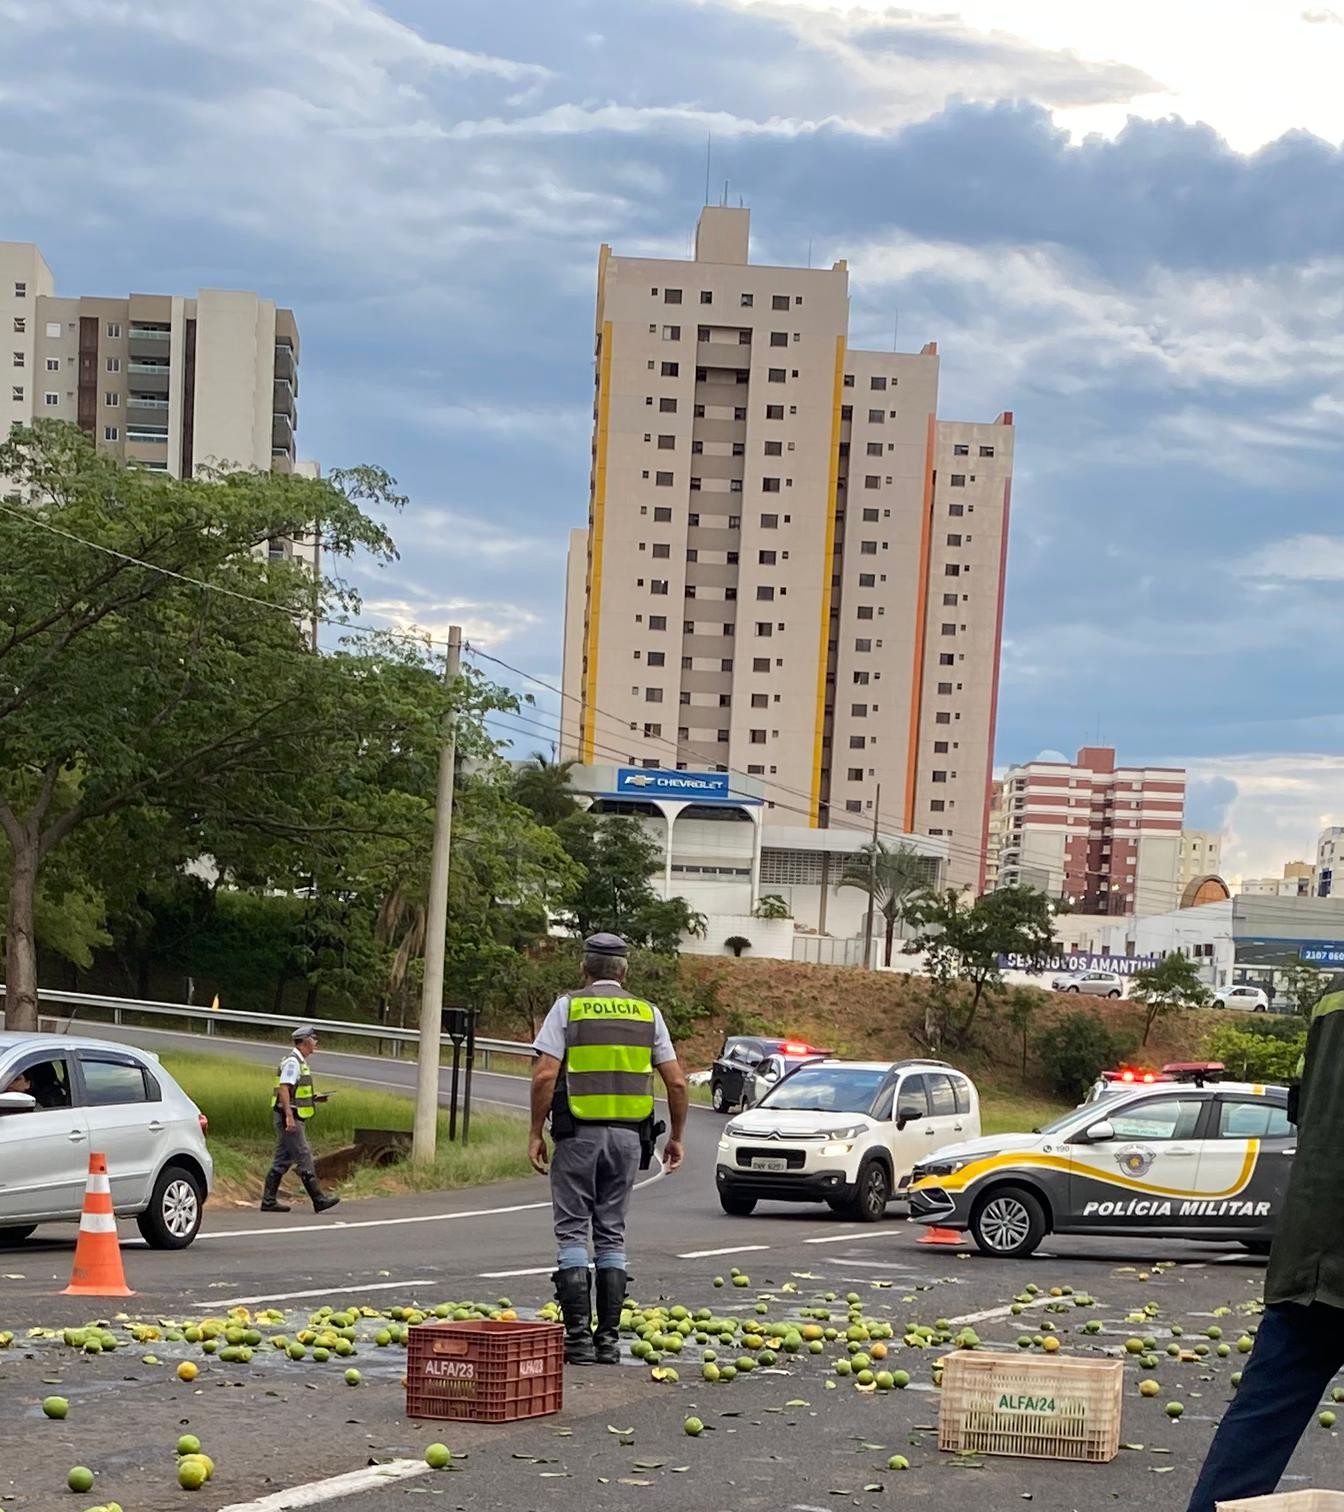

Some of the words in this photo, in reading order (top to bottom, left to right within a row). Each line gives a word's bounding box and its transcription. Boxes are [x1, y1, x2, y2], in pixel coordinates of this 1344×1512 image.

[657, 777, 723, 789] CHEVROLET
[583, 1001, 641, 1015] POLÍCIA
[1083, 1200, 1172, 1216] POLÍCIA
[1179, 1201, 1271, 1216] MILITAR
[425, 1360, 475, 1378] ALFA/23
[999, 1394, 1056, 1412] ALFA/24
